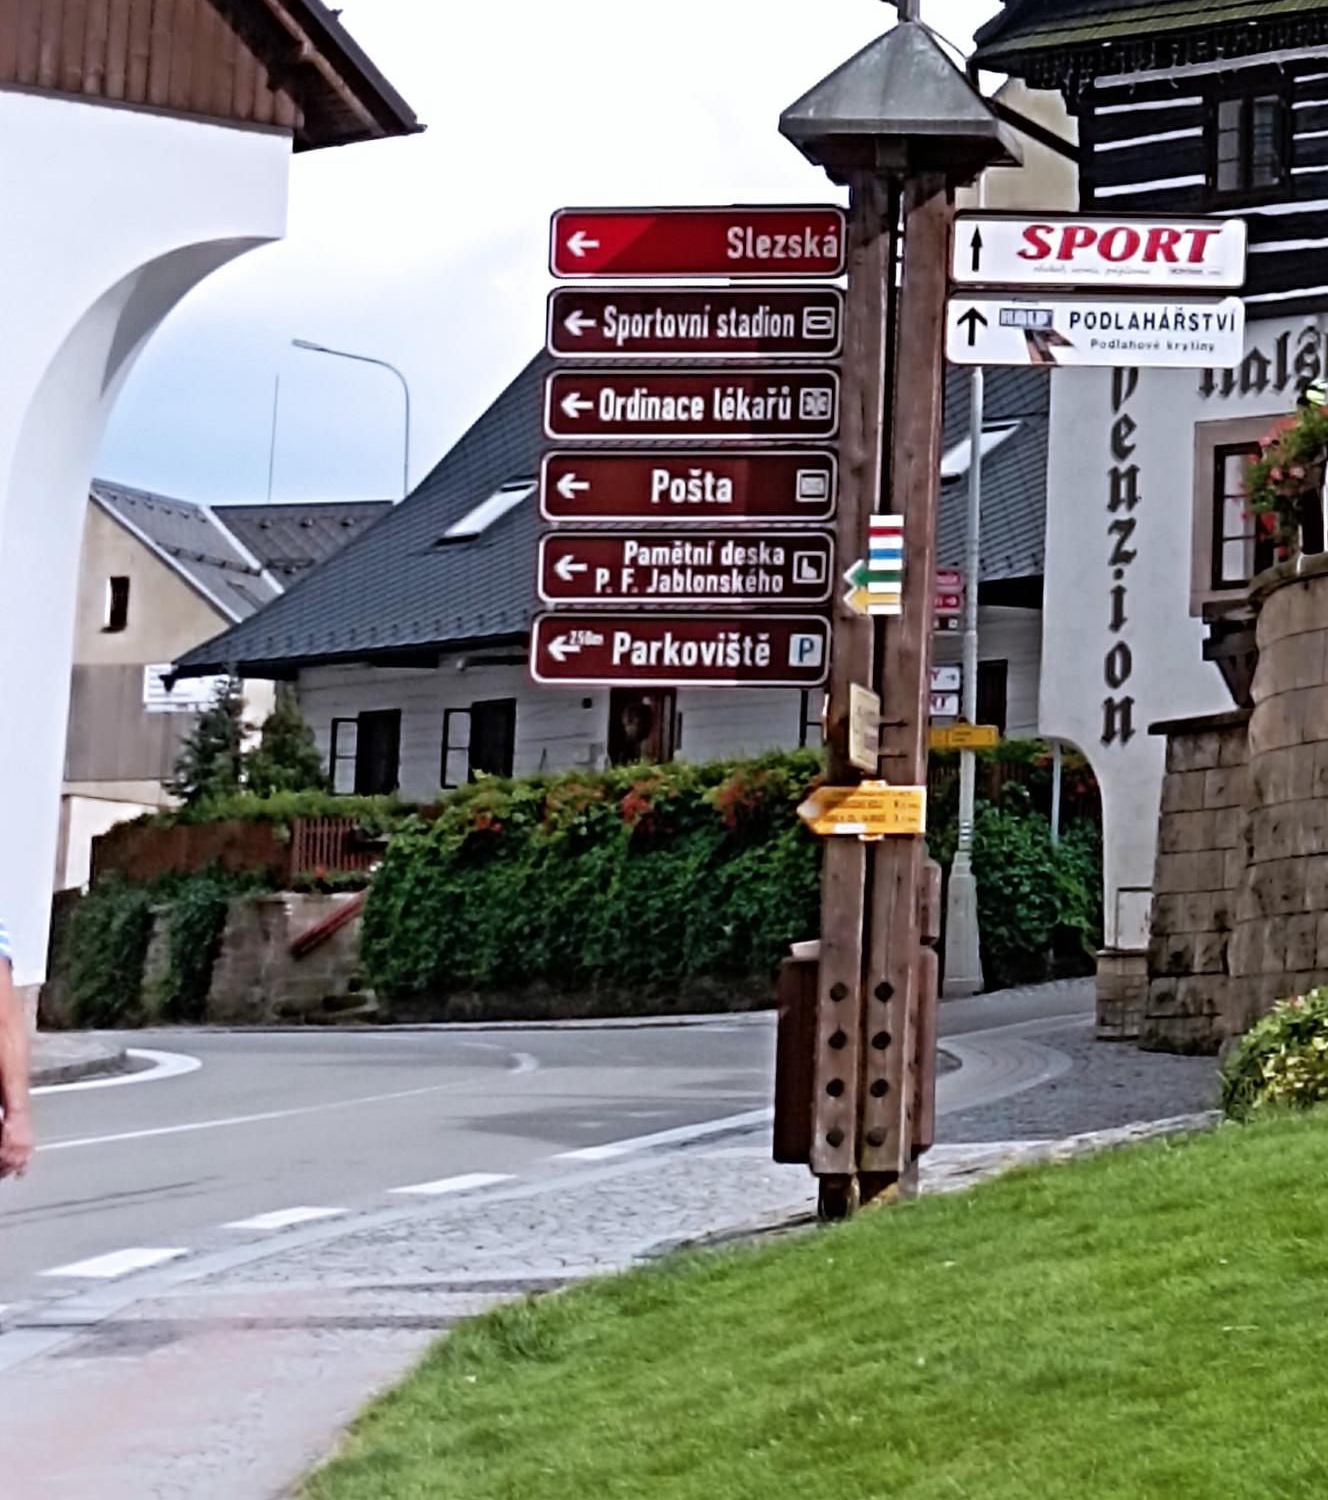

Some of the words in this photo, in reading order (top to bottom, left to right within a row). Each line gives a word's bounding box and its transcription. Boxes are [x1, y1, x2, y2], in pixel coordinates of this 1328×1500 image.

[727, 225, 838, 259] Slezská
[1016, 224, 1222, 263] SPORT
[602, 304, 709, 346] Sportovní
[716, 305, 795, 338] stadion
[1069, 305, 1236, 333] PODLAHÁŘSTVÍ
[1090, 337, 1160, 352] Podlahové
[600, 386, 705, 422] Ordinace
[713, 385, 792, 422] lékařů
[651, 468, 734, 503] Pošta
[623, 540, 714, 567] Pamětní
[721, 540, 786, 567] deska
[595, 567, 613, 594] P.
[620, 567, 639, 594] F.
[646, 567, 784, 594] Jablonského
[612, 631, 771, 667] Parkoviště
[798, 636, 816, 663] P
